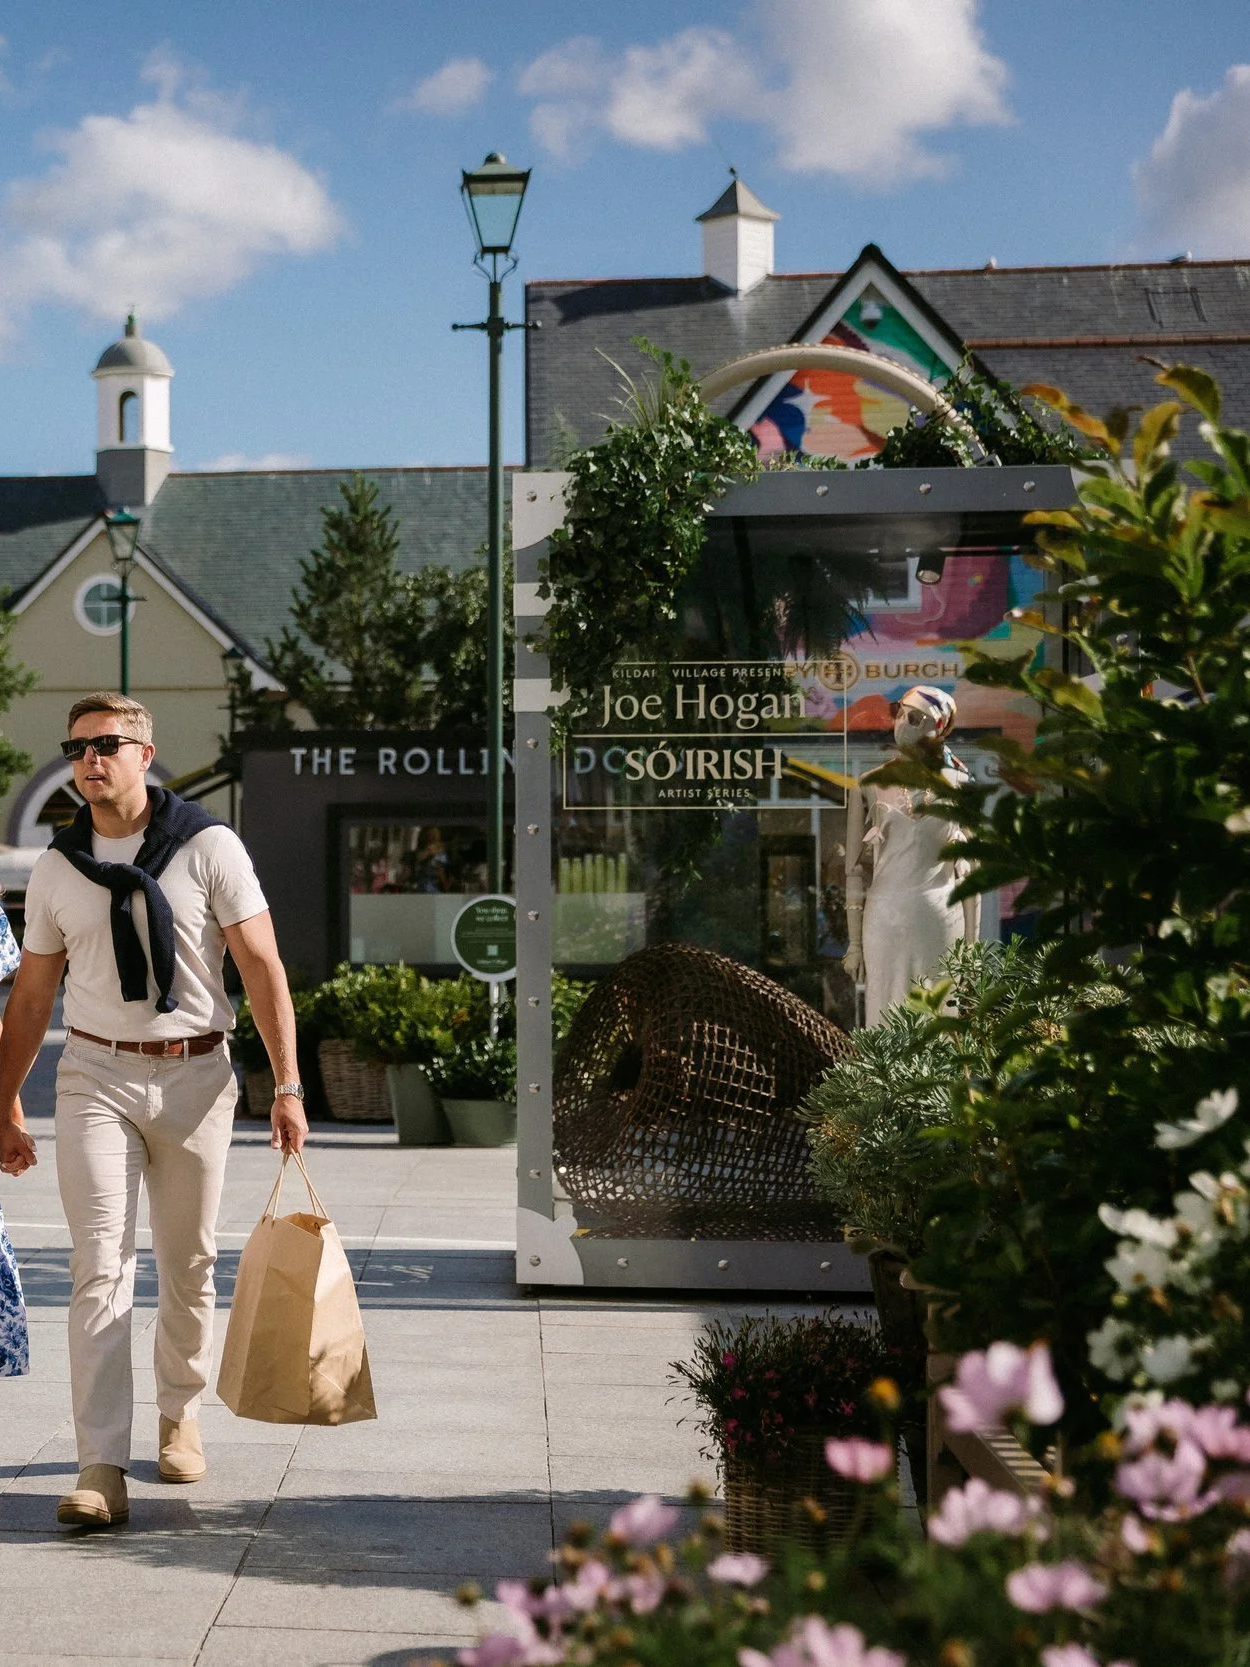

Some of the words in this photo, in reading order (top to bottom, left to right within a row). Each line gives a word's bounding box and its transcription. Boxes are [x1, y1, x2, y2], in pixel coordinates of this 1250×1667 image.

[612, 669, 656, 679] KILDA
[672, 668, 726, 678] VILLAGE
[865, 663, 958, 679] BURCH
[601, 684, 662, 729] Joe
[675, 684, 806, 730] Hogan
[290, 747, 356, 775] THE
[379, 747, 517, 775] ROLLIN
[685, 748, 783, 780] IRISH
[658, 789, 702, 798] ARTIST
[707, 788, 750, 798] SERIES
